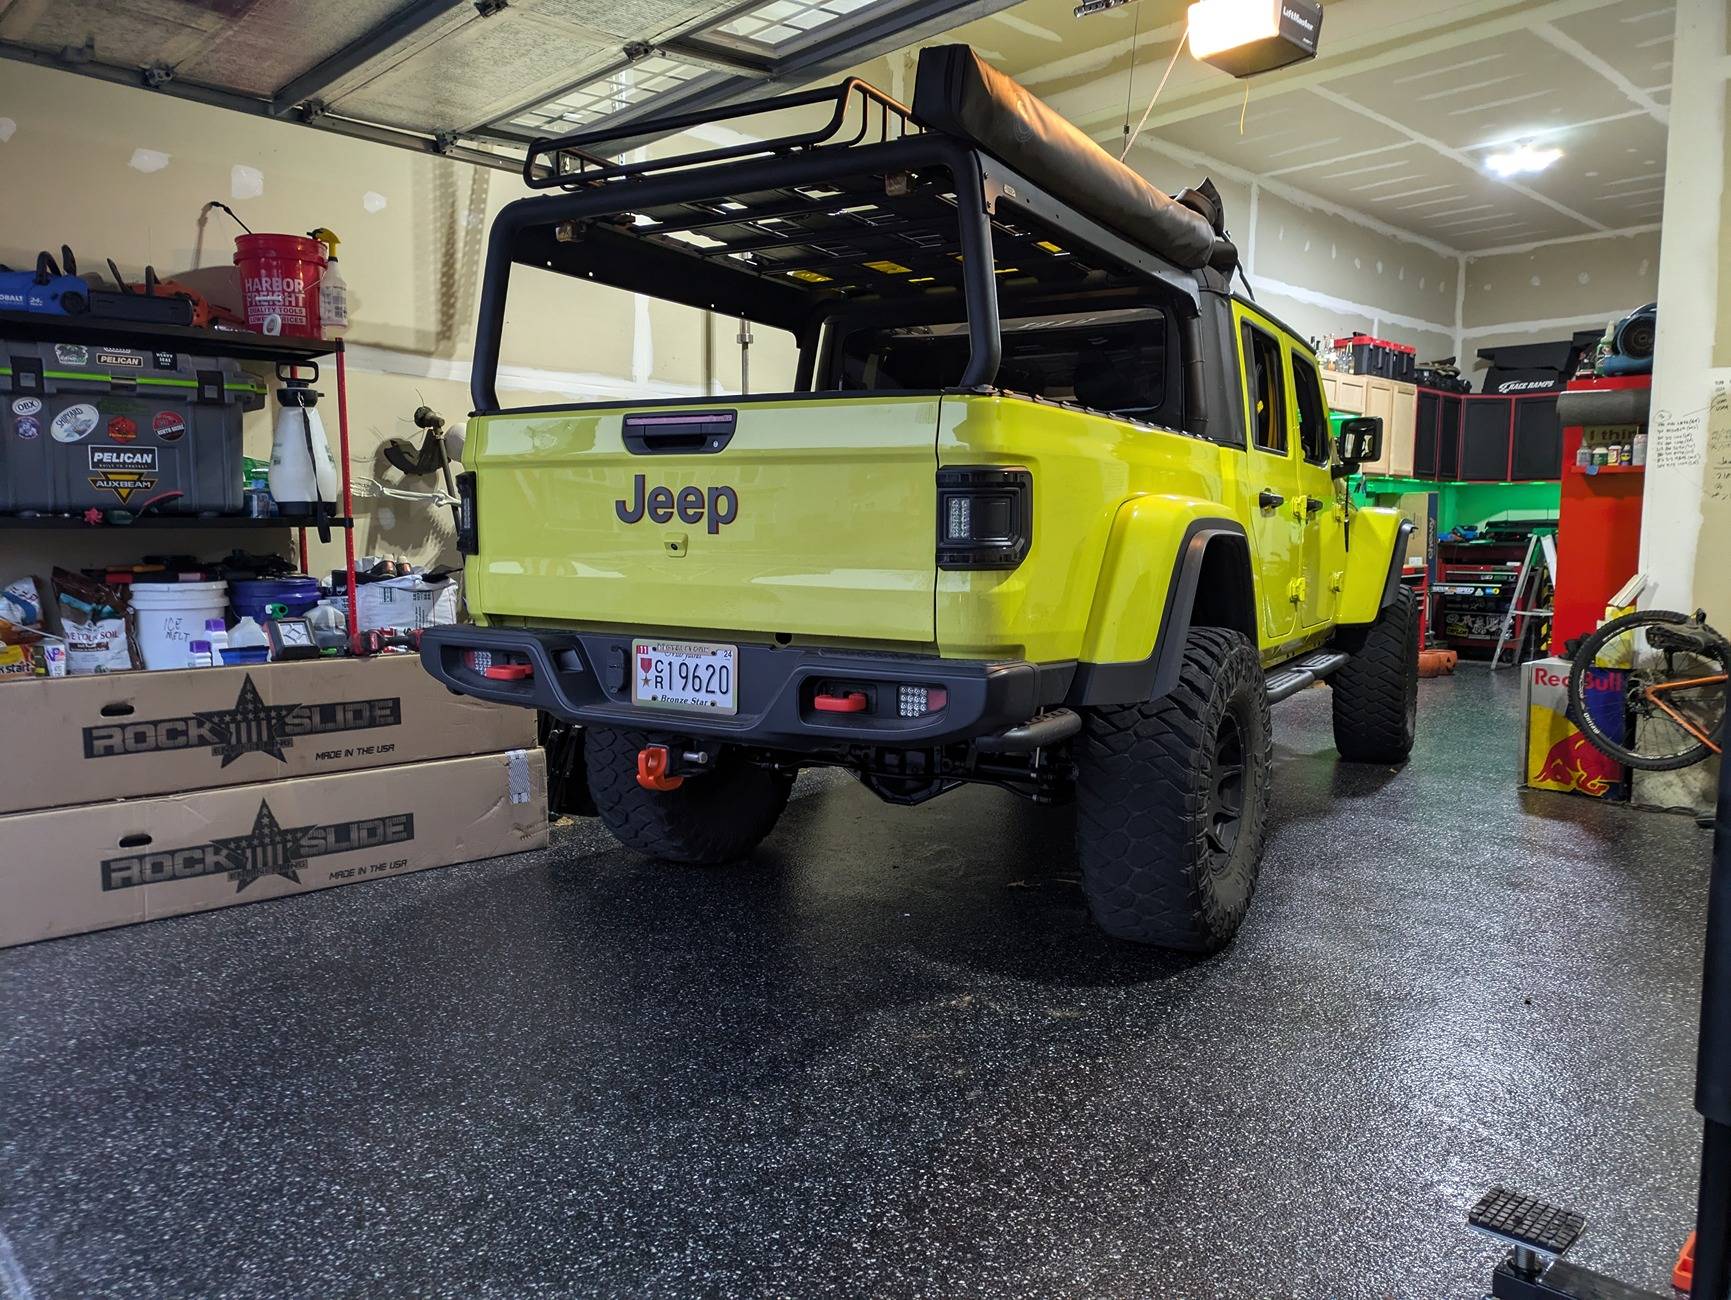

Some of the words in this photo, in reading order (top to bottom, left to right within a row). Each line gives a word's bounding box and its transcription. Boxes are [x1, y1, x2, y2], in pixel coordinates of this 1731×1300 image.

[245, 278, 304, 292] HARBOR
[247, 293, 305, 306] FREIGHT
[249, 307, 277, 315] QUALITY
[101, 356, 140, 365] PELICAN
[1527, 380, 1555, 389] RAMPS
[17, 401, 36, 410] OBX
[94, 452, 152, 463] PELICAN
[615, 474, 738, 534] Jeep
[164, 618, 183, 631] ICE
[100, 630, 119, 639] SOIL
[165, 632, 191, 642] MELT
[723, 650, 732, 658] 24
[668, 661, 729, 694] 19620
[660, 695, 688, 704] Bronze
[690, 697, 708, 706] Star
[93, 719, 222, 756] ROCK
[284, 700, 393, 733] SLIDE
[315, 750, 342, 761] MADE
[344, 749, 353, 757] IN
[356, 746, 374, 756] THE
[376, 743, 395, 753] USA
[110, 846, 236, 888] ROCK
[300, 815, 407, 855] SLIDE
[328, 868, 355, 881] MADE
[358, 866, 367, 875] IN
[370, 862, 387, 872] THE
[389, 858, 408, 869] USA
